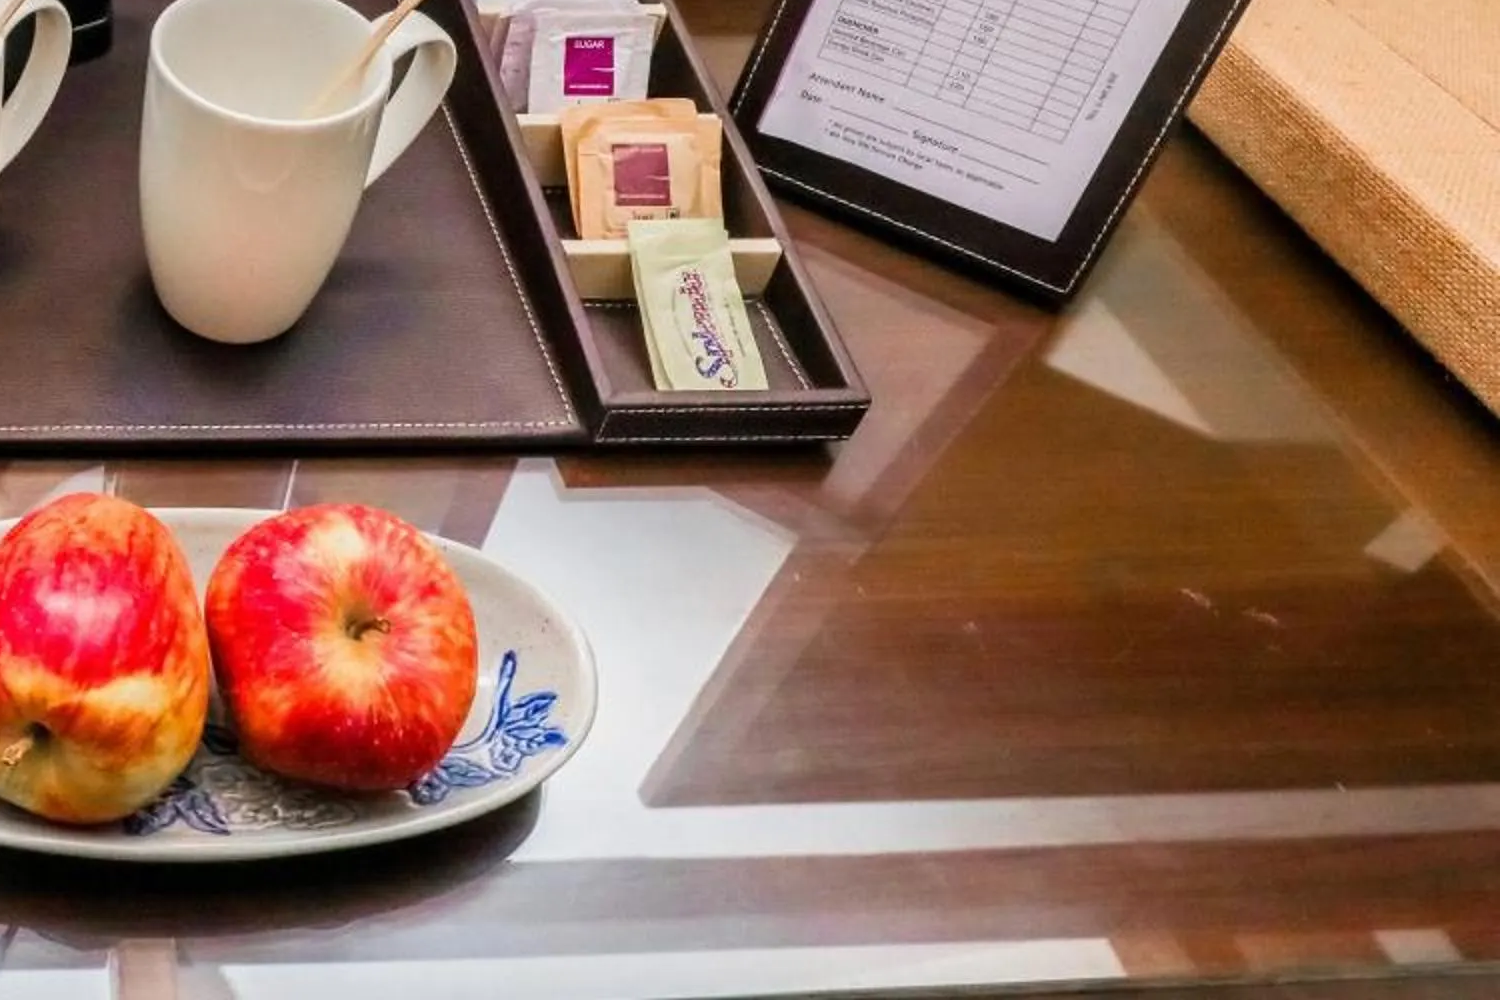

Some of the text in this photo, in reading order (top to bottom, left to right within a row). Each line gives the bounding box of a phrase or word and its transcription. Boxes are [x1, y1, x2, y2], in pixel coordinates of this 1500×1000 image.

[573, 39, 605, 49] SUGAR
[809, 71, 885, 103] Attendant Name
[801, 90, 821, 103] Date
[910, 130, 959, 154] Signature
